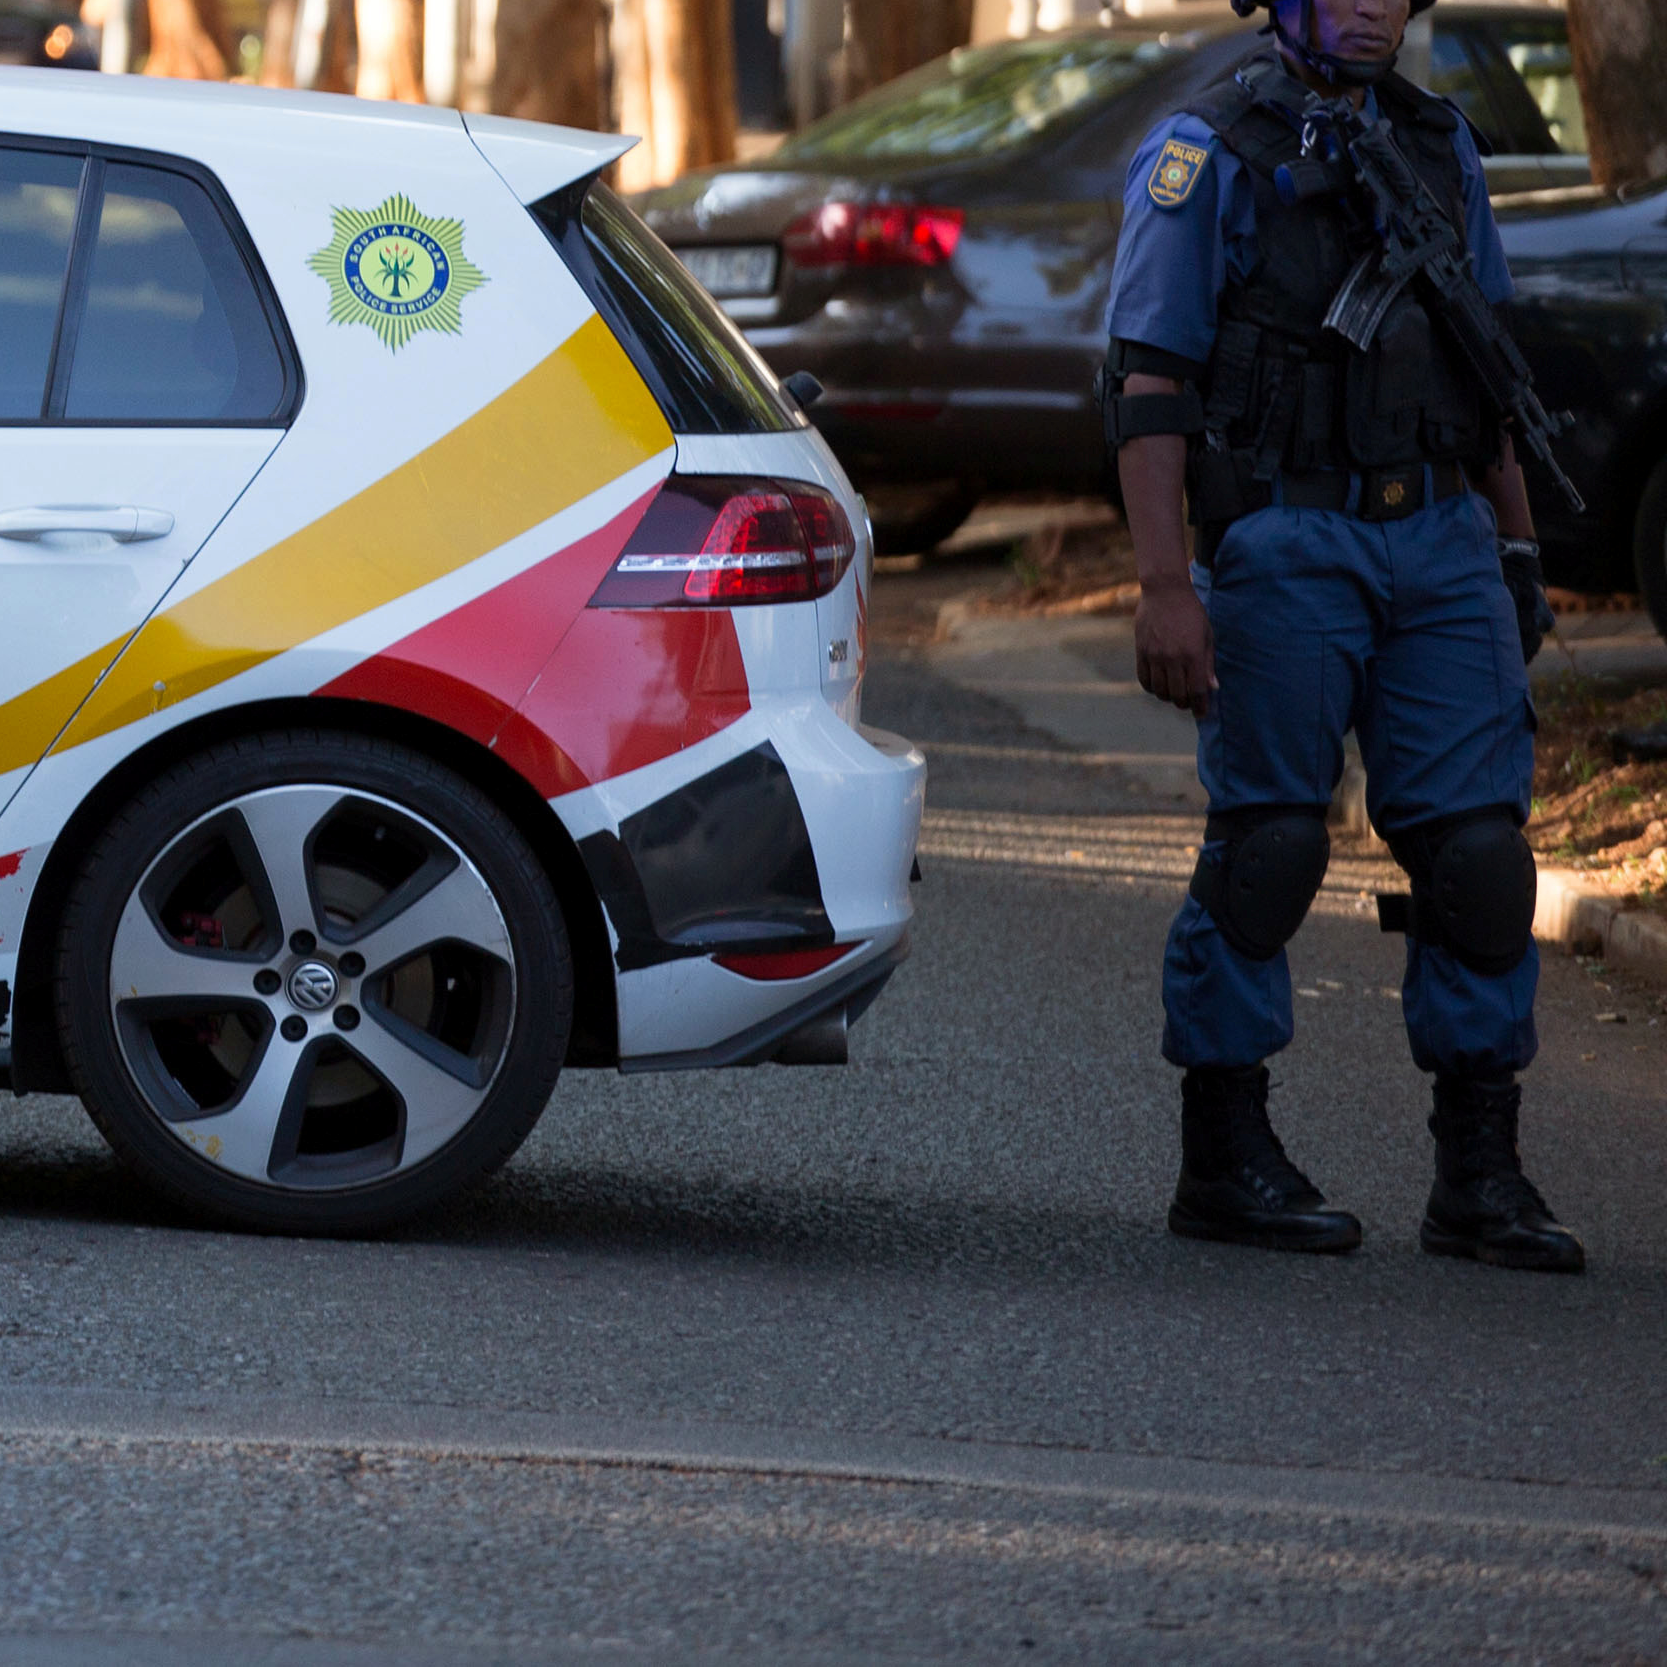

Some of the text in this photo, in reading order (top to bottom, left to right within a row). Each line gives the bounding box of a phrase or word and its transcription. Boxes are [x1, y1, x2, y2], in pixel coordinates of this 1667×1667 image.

[1166, 142, 1204, 165] POLICE
[349, 225, 446, 271] SOUTH AFRICAN
[350, 275, 441, 314] POLICE SERVICE
